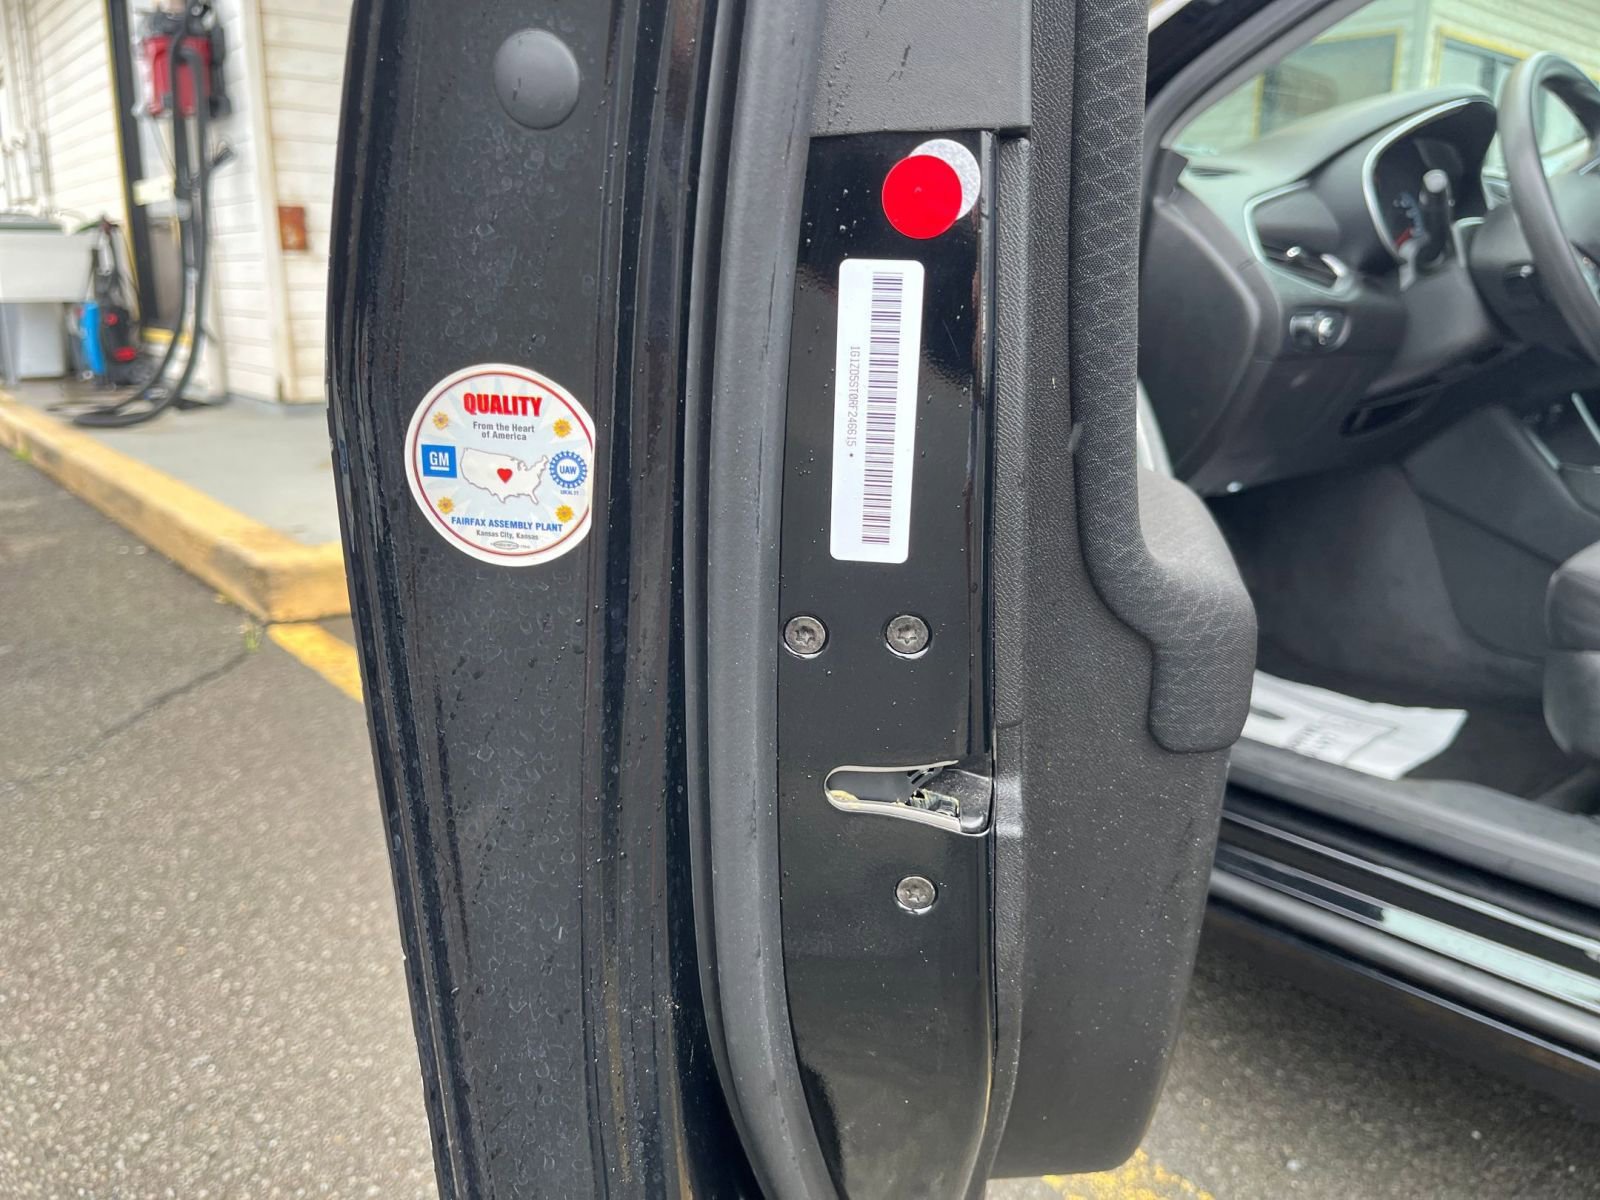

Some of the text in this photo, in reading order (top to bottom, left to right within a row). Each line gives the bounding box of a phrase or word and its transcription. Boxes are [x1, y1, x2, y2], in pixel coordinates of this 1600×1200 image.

[847, 346, 861, 447] 1G1ZD5ST0RF246615
[463, 392, 543, 417] QUALITY
[473, 421, 535, 433] From the Heart
[481, 431, 527, 441] of America
[429, 451, 450, 467] GM
[559, 465, 577, 475] UAW
[451, 516, 563, 533] FAIRFAX ASSEMBLY PLANT
[476, 530, 539, 541] Kansas City, Kansas
